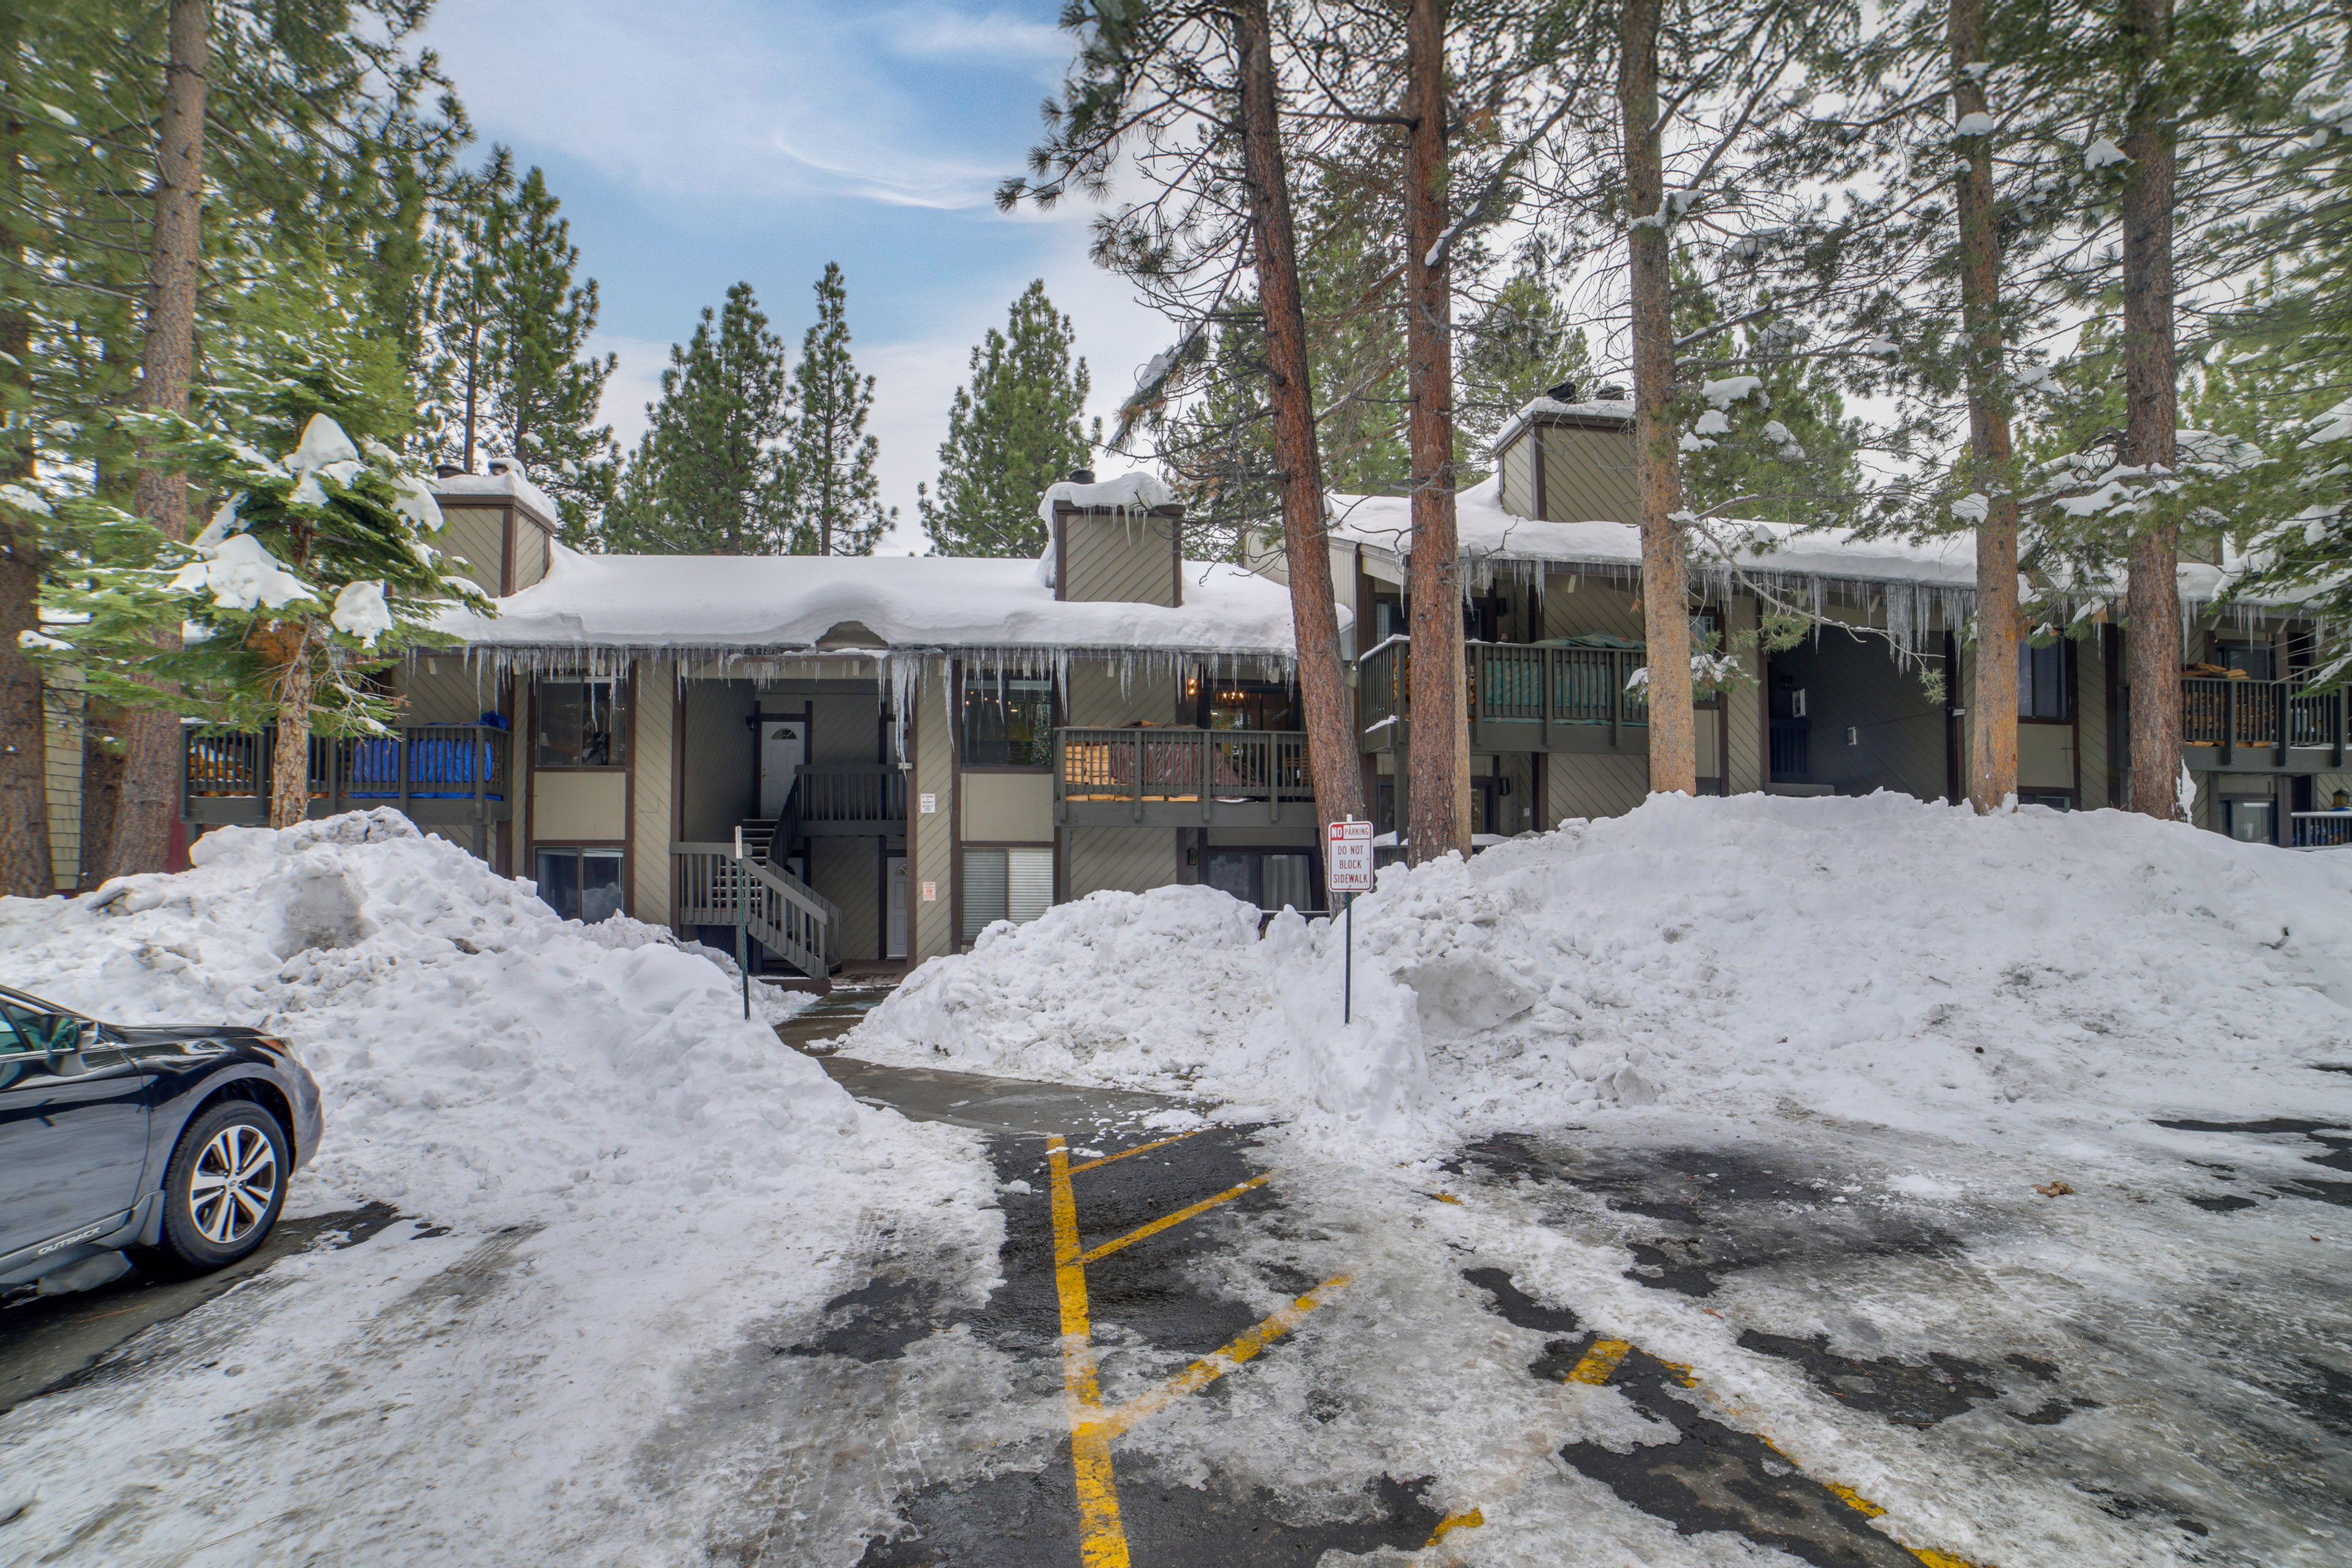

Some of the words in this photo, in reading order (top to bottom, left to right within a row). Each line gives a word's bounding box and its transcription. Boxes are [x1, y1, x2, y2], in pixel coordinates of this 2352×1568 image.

[1332, 827, 1343, 838] NO
[1338, 846, 1347, 855] DO
[1351, 845, 1363, 854] NOT
[1340, 860, 1362, 869] BLOCK
[1333, 874, 1368, 883] SIDEWALK
[37, 1226, 102, 1255] OUTBACK
